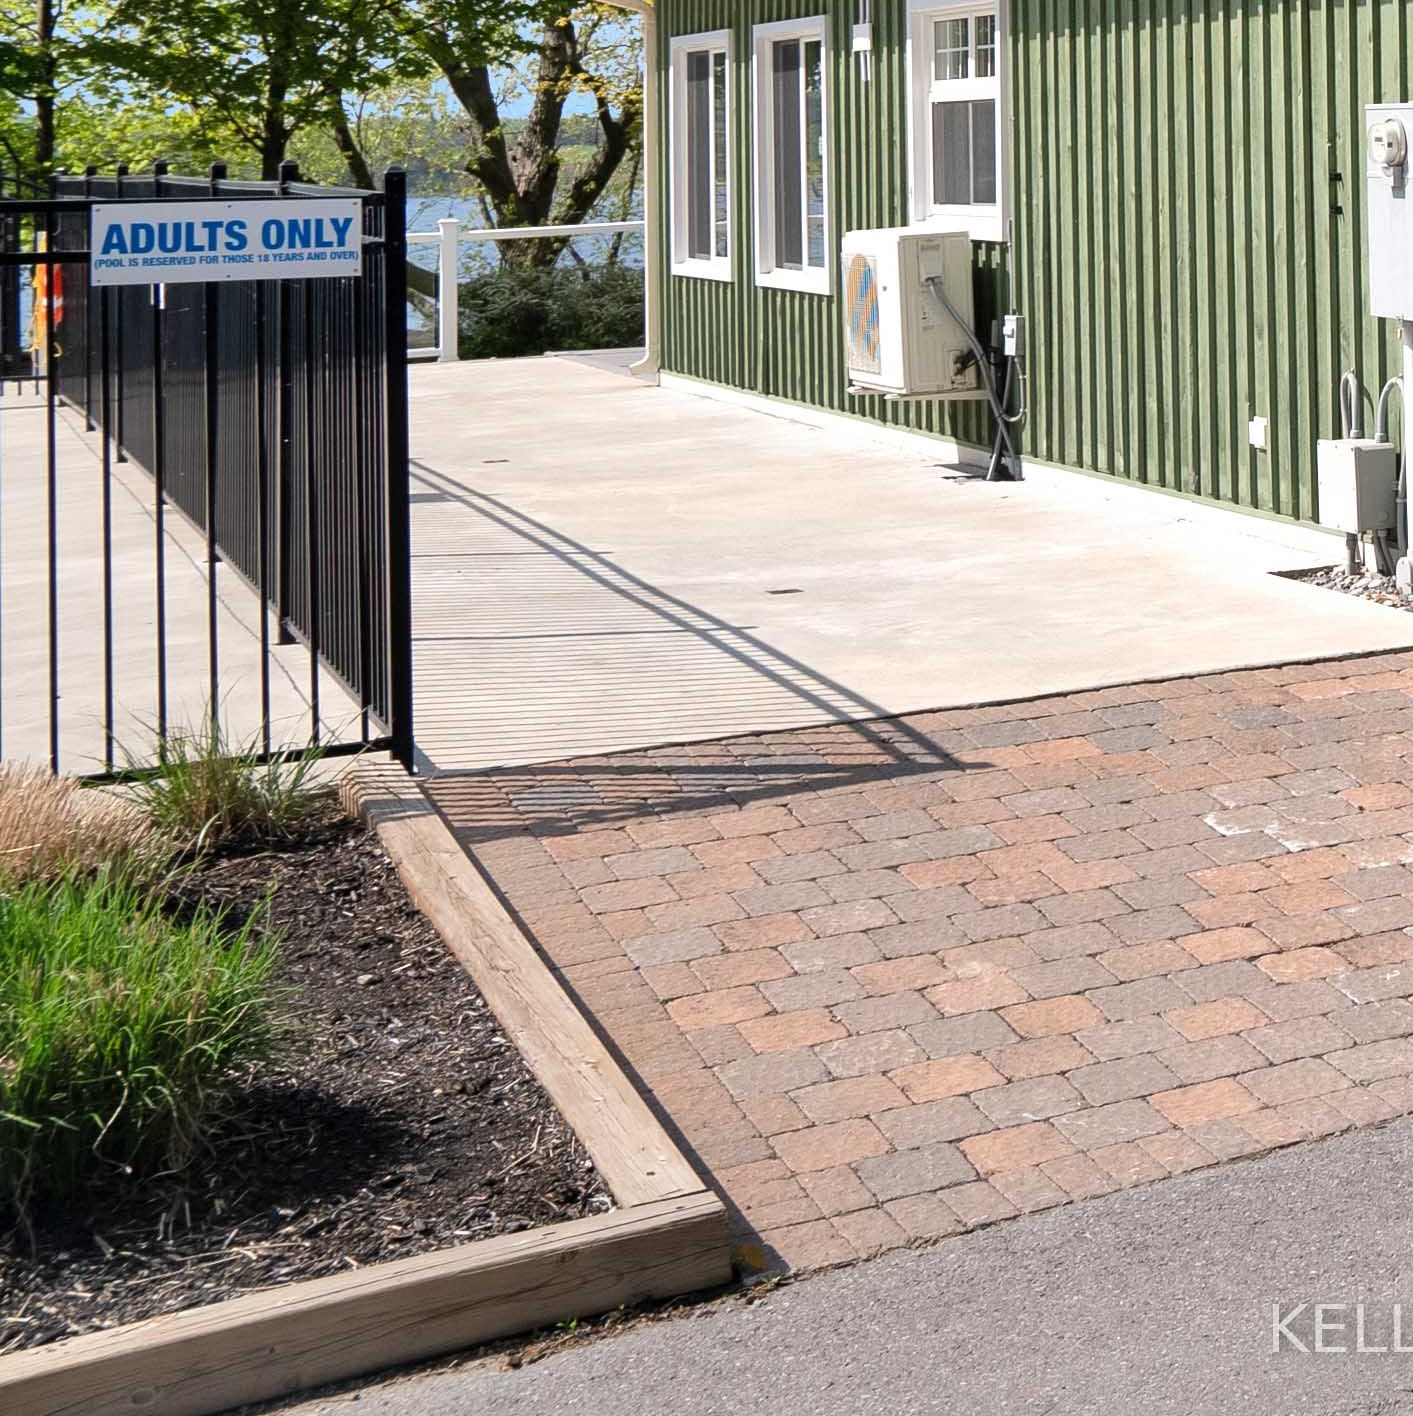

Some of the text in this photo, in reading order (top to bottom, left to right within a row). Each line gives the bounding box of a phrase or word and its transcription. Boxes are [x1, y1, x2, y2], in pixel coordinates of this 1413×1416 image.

[101, 217, 353, 255] ADULTS ONLY
[95, 250, 359, 269] (POOL IS RESERVED FOR THOSE 18 YEARS AND OVER)
